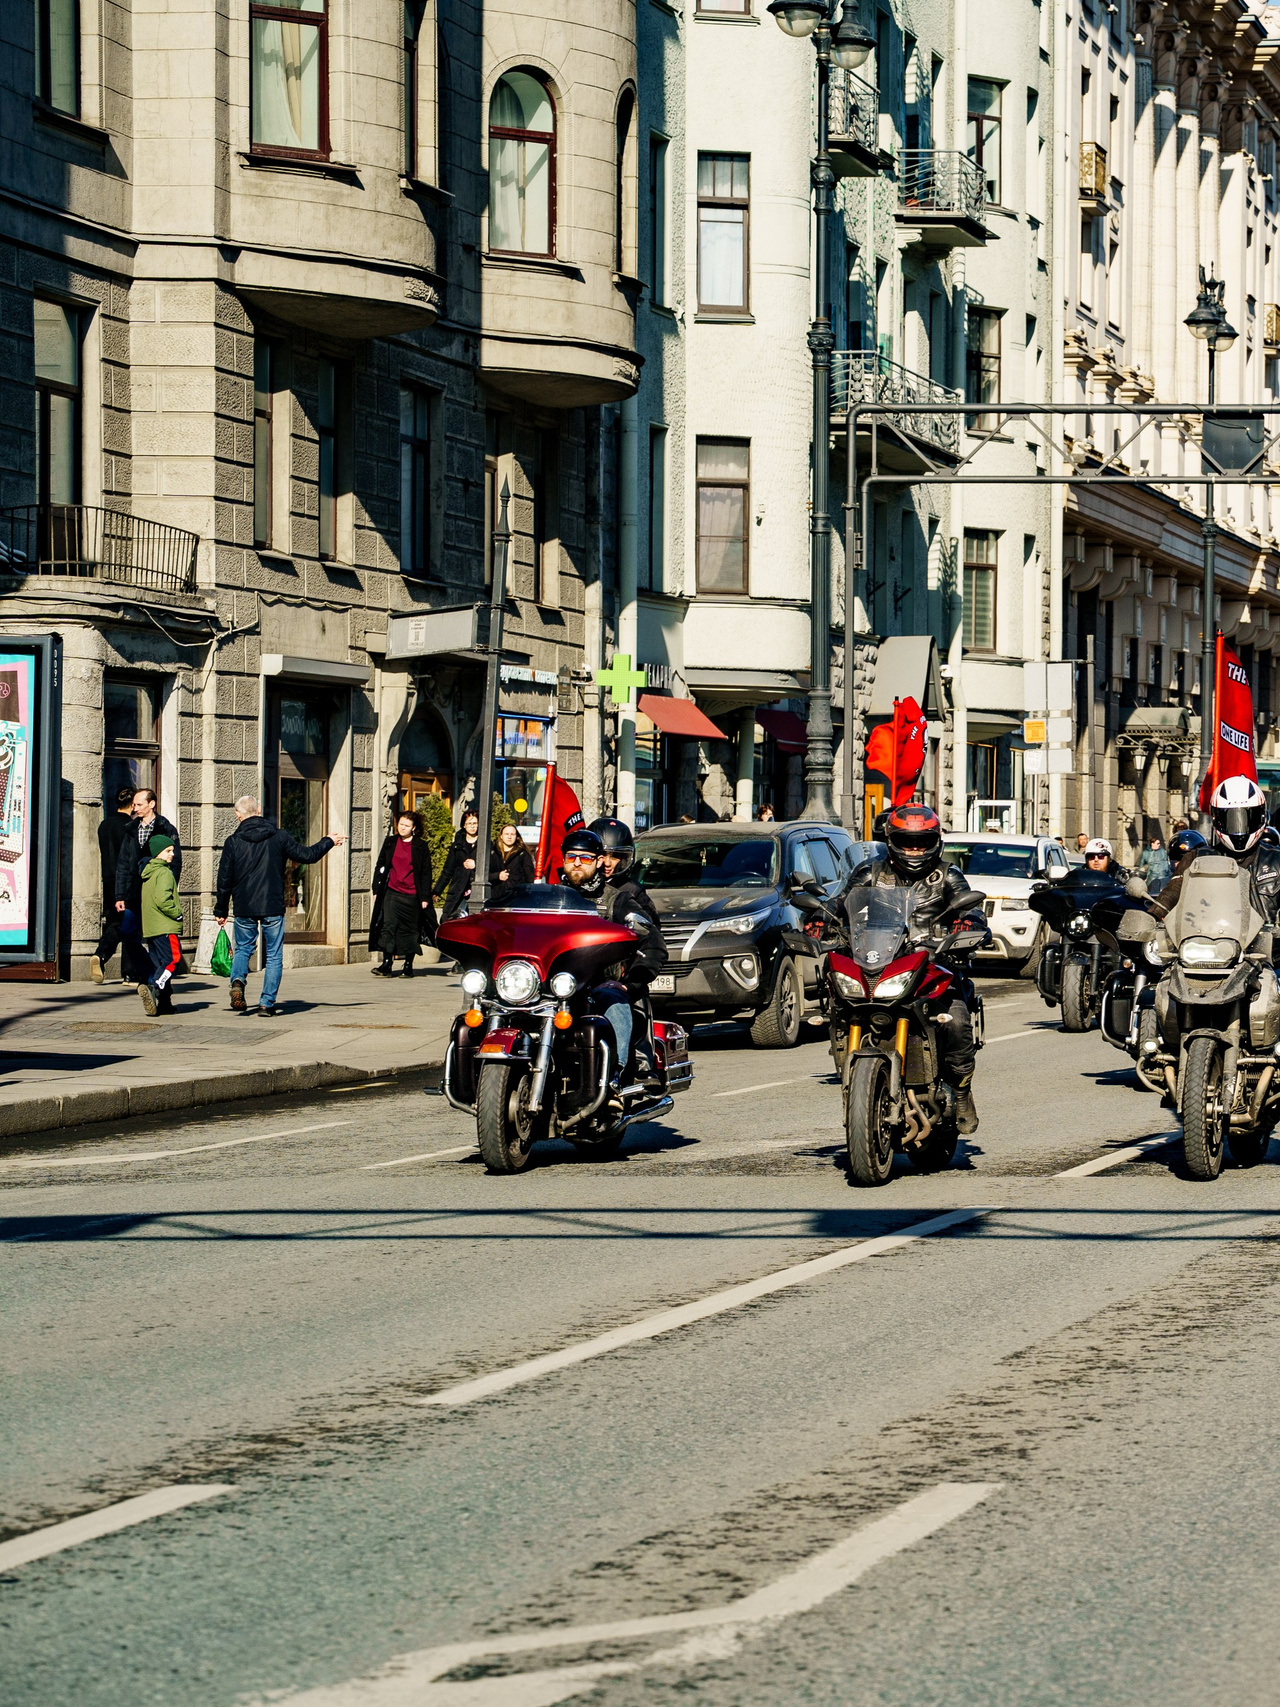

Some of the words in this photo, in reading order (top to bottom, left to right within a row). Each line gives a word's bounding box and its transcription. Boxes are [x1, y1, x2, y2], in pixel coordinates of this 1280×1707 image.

[1221, 724, 1233, 742] ONE
[1234, 731, 1248, 749] LIFE
[567, 813, 581, 826] THE
[656, 977, 671, 986] 198
